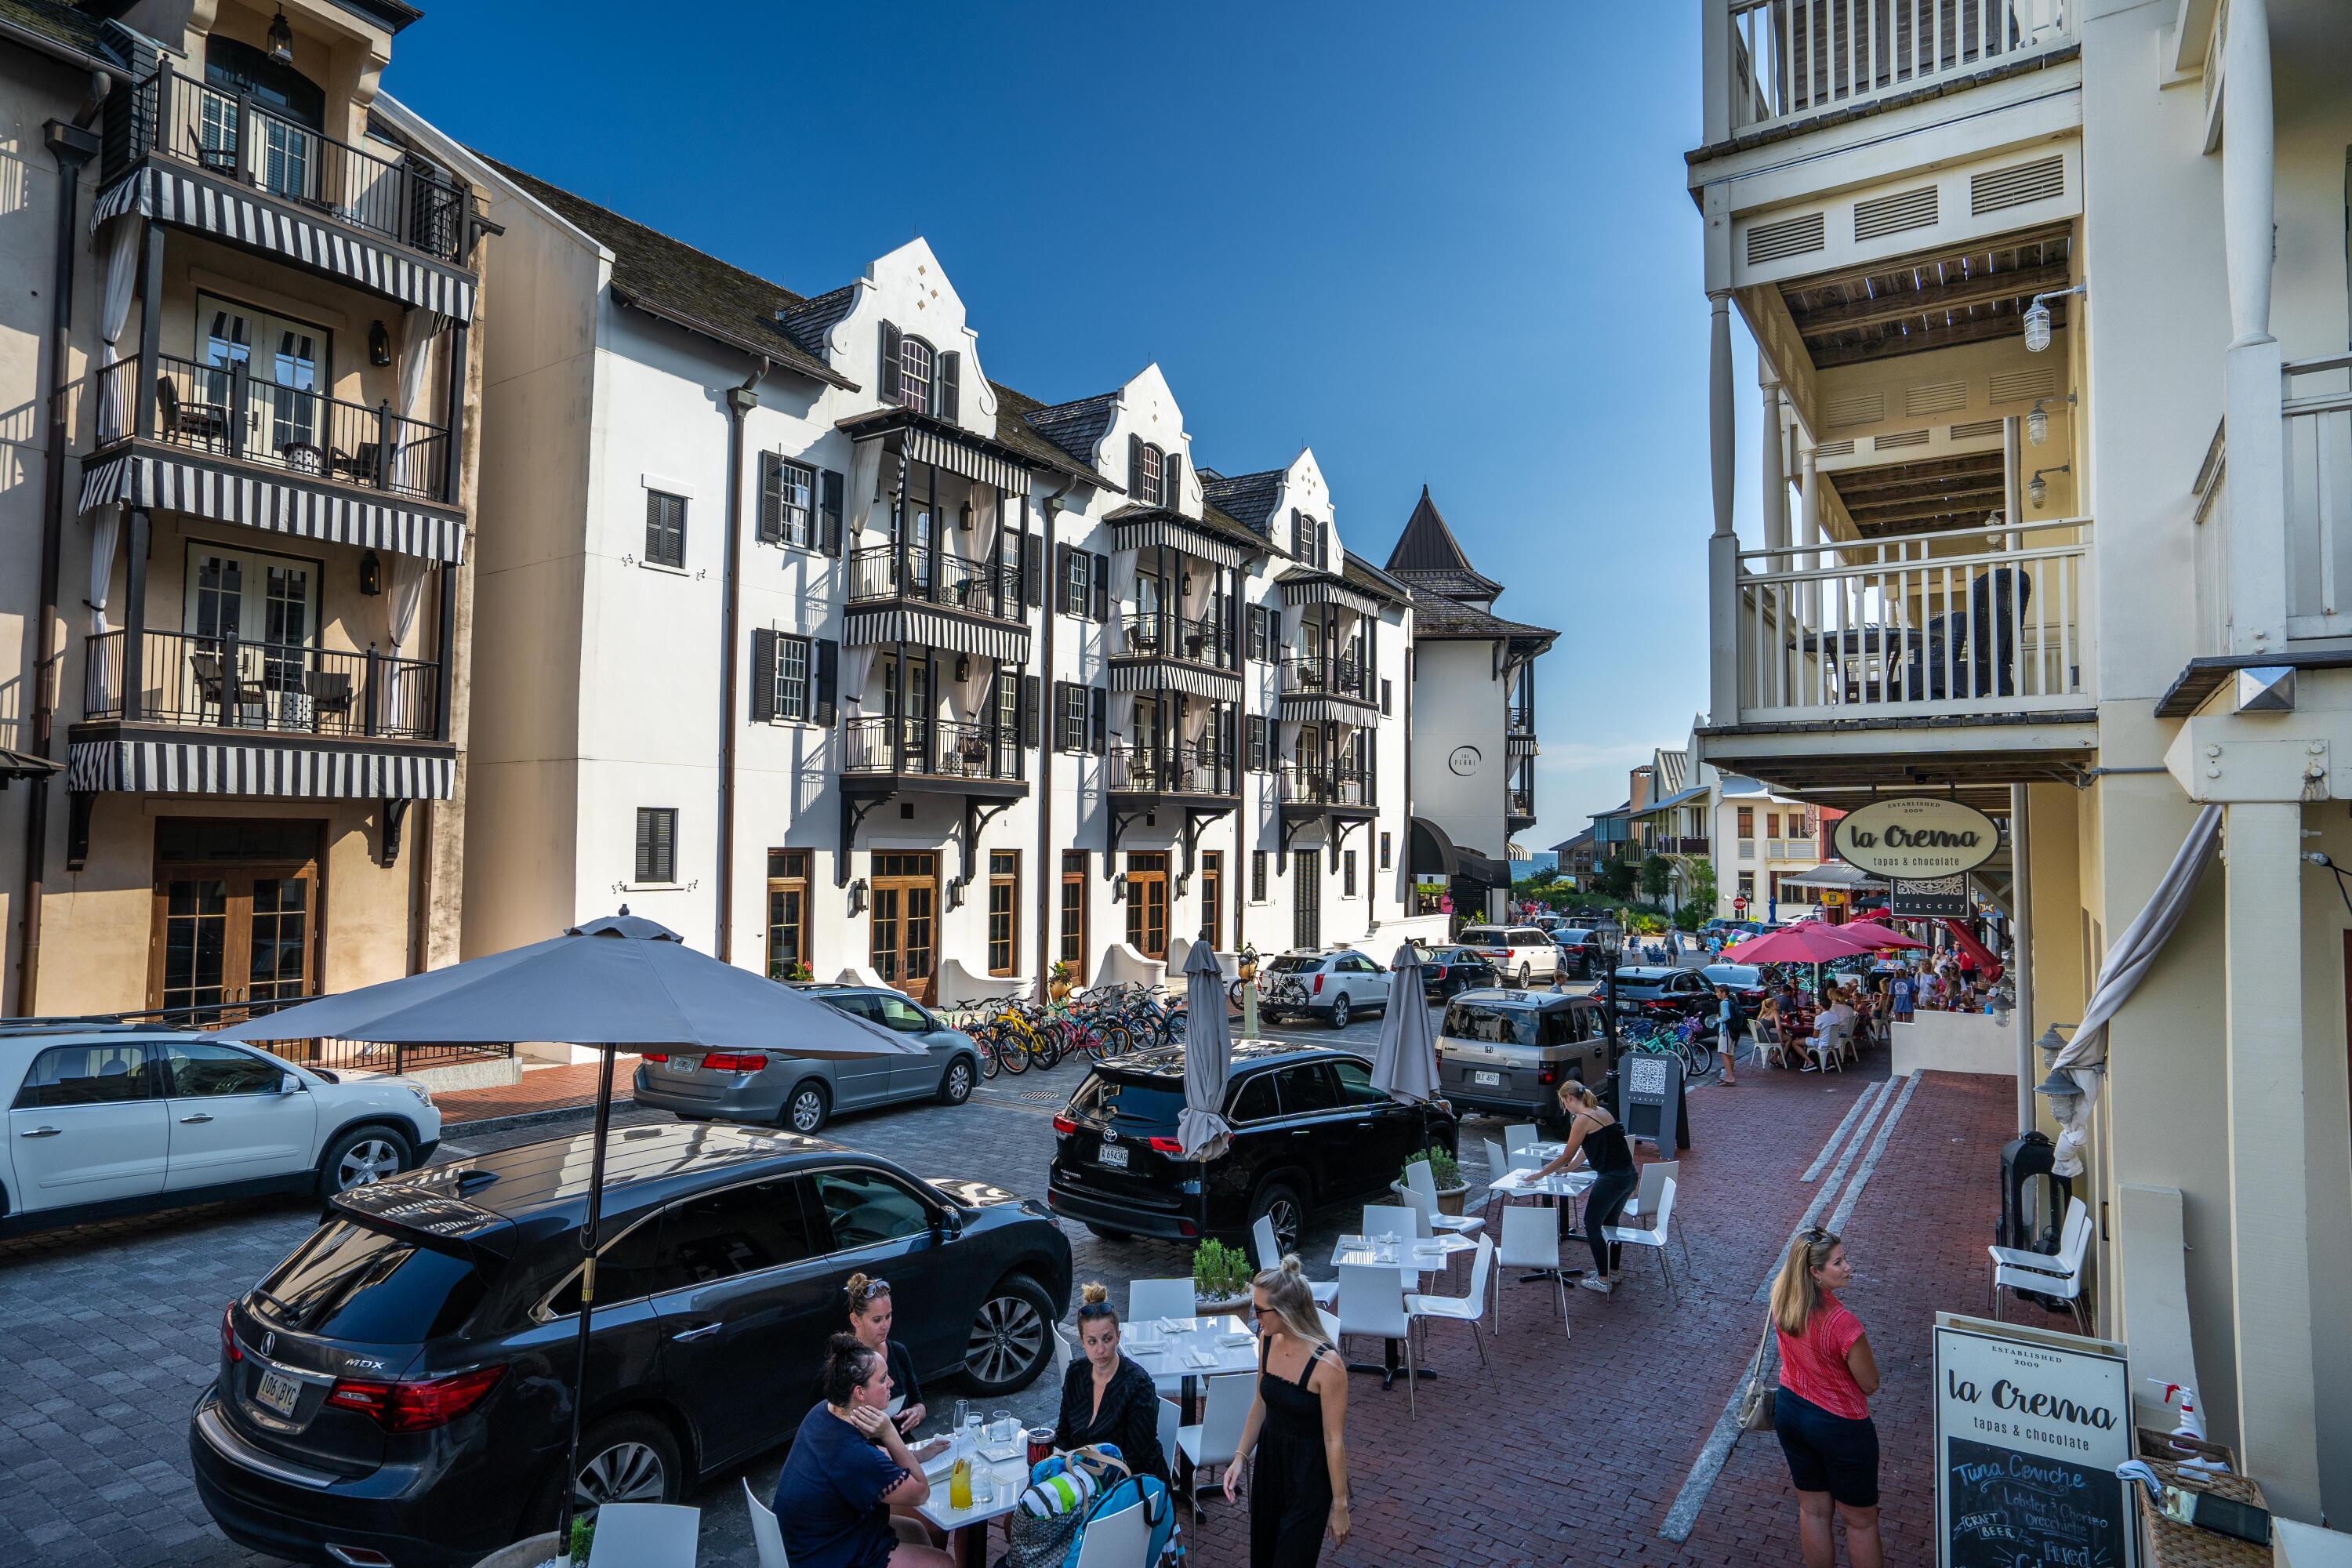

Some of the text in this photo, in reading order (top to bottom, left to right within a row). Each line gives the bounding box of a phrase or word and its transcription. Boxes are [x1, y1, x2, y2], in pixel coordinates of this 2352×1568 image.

[1850, 825, 1981, 848] la Crema
[1874, 856, 1959, 866] tapas & chocolate
[1896, 902, 1965, 913] tracery
[1991, 1345, 2063, 1363] ESTABLISHED
[345, 1358, 387, 1370] MDX
[2014, 1359, 2040, 1369] 2009
[262, 1374, 296, 1406] 106 BYC
[1948, 1369, 2118, 1431] la Crema
[1974, 1416, 2089, 1451] tapas & chocolate
[1951, 1455, 2086, 1488] Tuna Ceviche
[2003, 1486, 2047, 1512] Lobster
[2059, 1504, 2109, 1529] Chorizo
[1965, 1512, 1998, 1527] CRAFT
[1981, 1526, 2016, 1539] BEER
